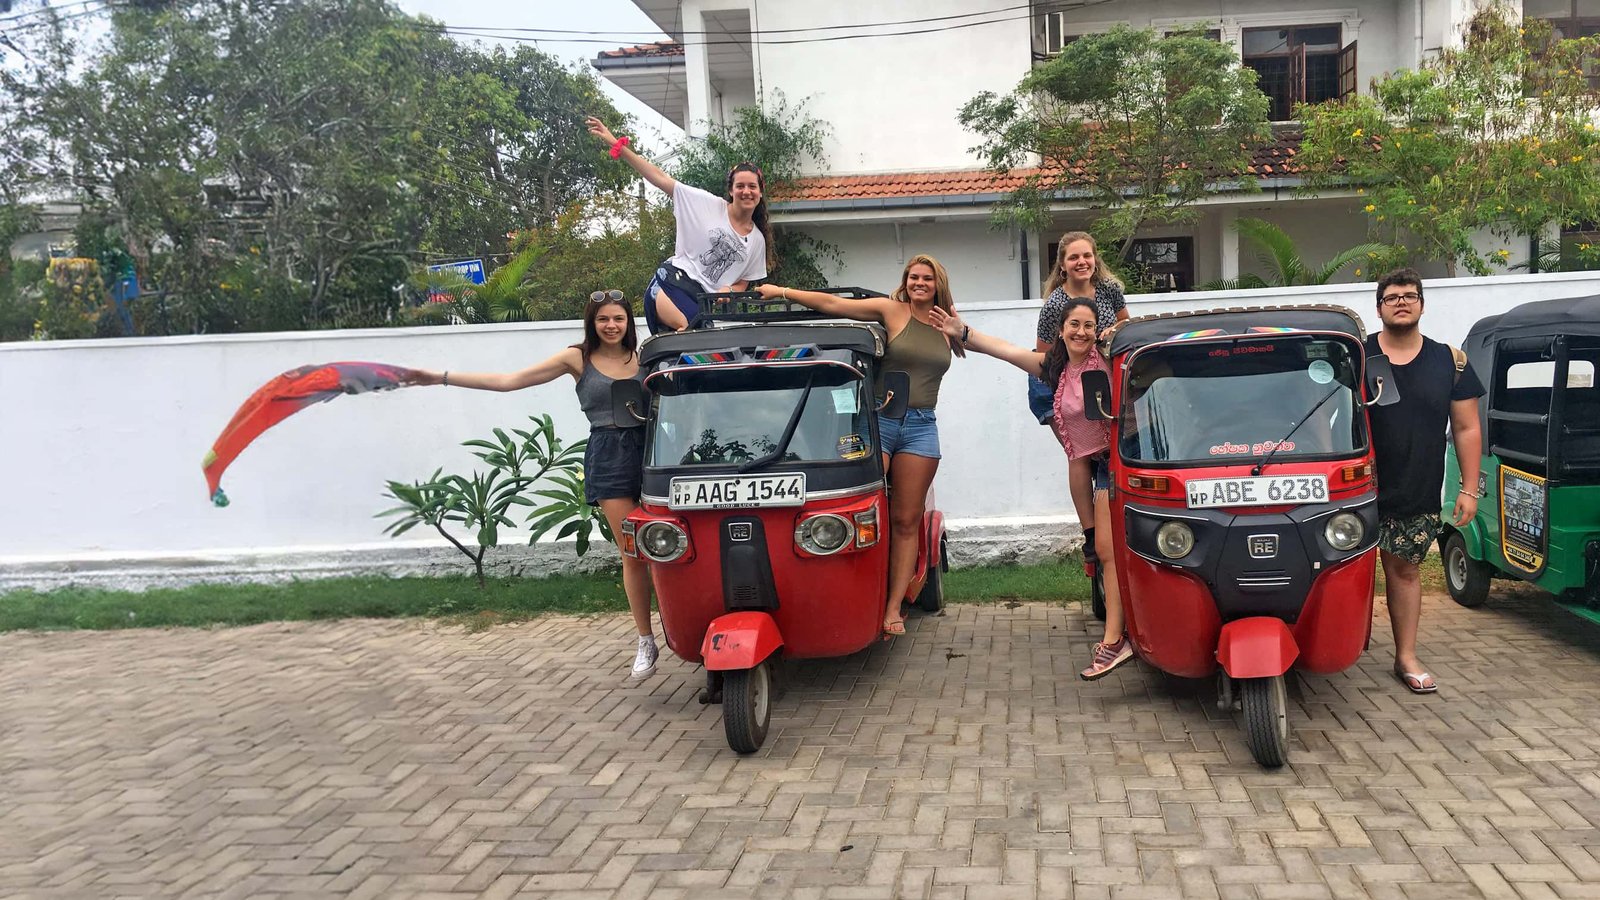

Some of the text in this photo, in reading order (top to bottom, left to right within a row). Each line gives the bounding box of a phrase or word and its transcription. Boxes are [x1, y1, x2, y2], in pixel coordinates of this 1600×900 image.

[695, 482, 738, 503] AAG
[747, 478, 800, 501] 1544
[1212, 481, 1257, 503] ABE
[1267, 478, 1326, 501] 6238
[1254, 542, 1274, 554] RE
